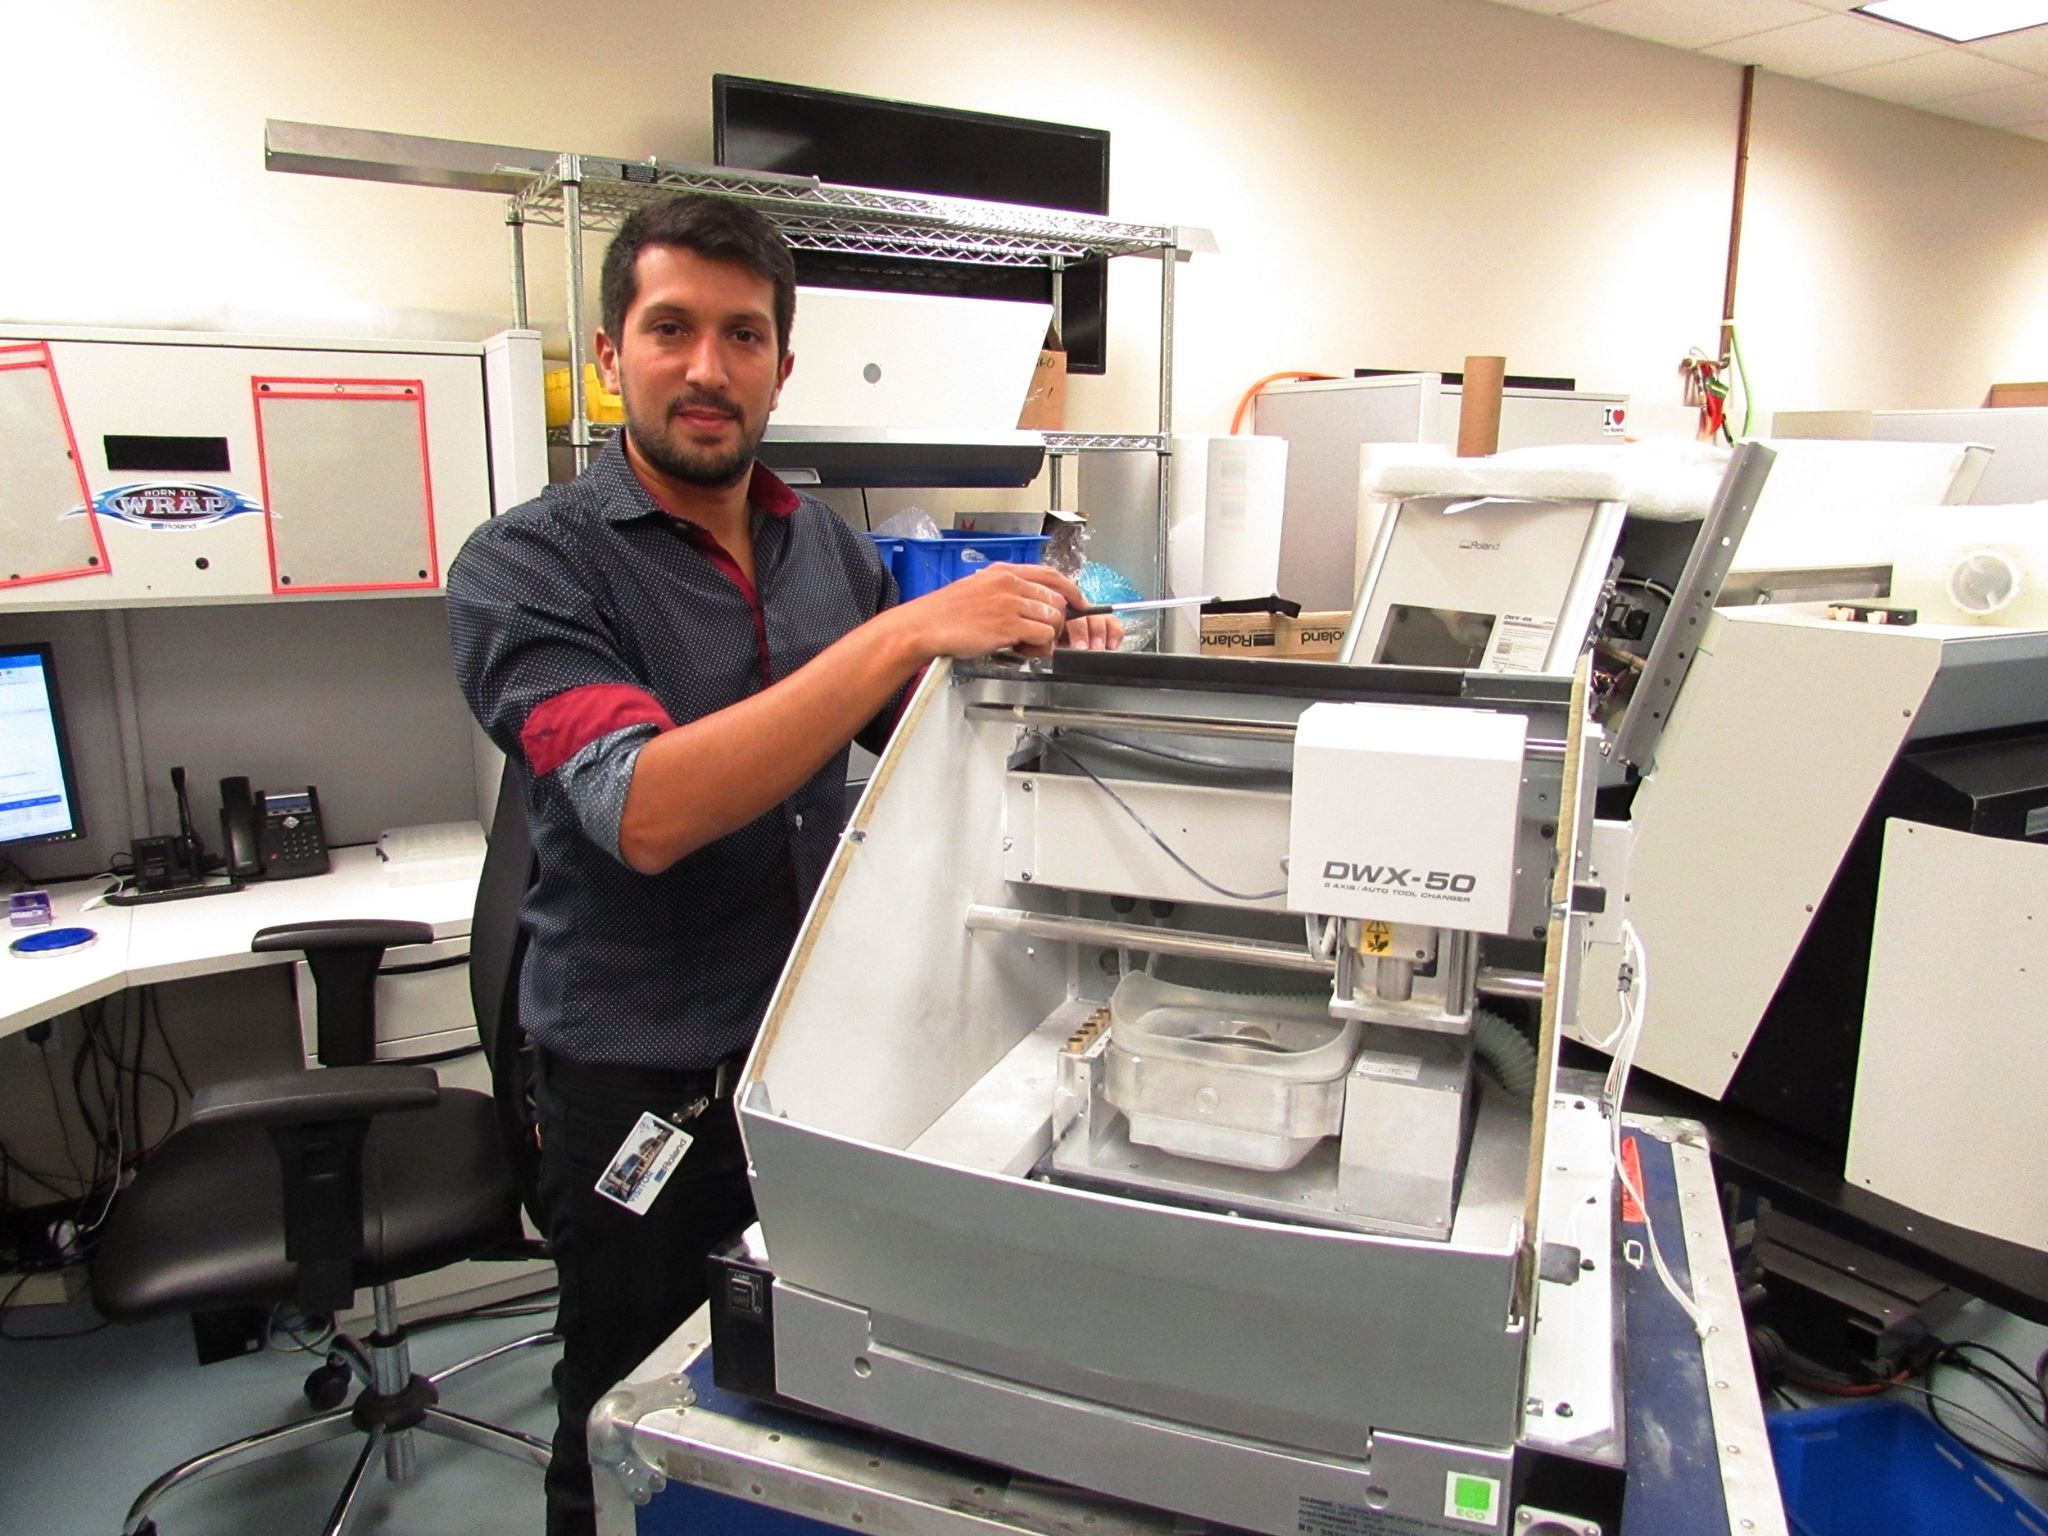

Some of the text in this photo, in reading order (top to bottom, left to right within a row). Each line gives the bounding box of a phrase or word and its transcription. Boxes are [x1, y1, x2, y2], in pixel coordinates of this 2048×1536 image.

[1604, 408, 1612, 426] I
[144, 489, 196, 497] BORN TO
[115, 496, 228, 515] WRAP
[164, 522, 196, 530] Roland
[1301, 631, 1344, 645] oland
[1322, 861, 1477, 894] DWX-50
[1333, 883, 1356, 891] AXIS
[1361, 886, 1389, 894] AUTO
[1392, 889, 1418, 897] TOOL
[1420, 892, 1471, 903] CHANGER
[662, 1138, 687, 1170] Roland
[628, 1170, 654, 1202] VISITOR
[1456, 1507, 1486, 1521] ECO
